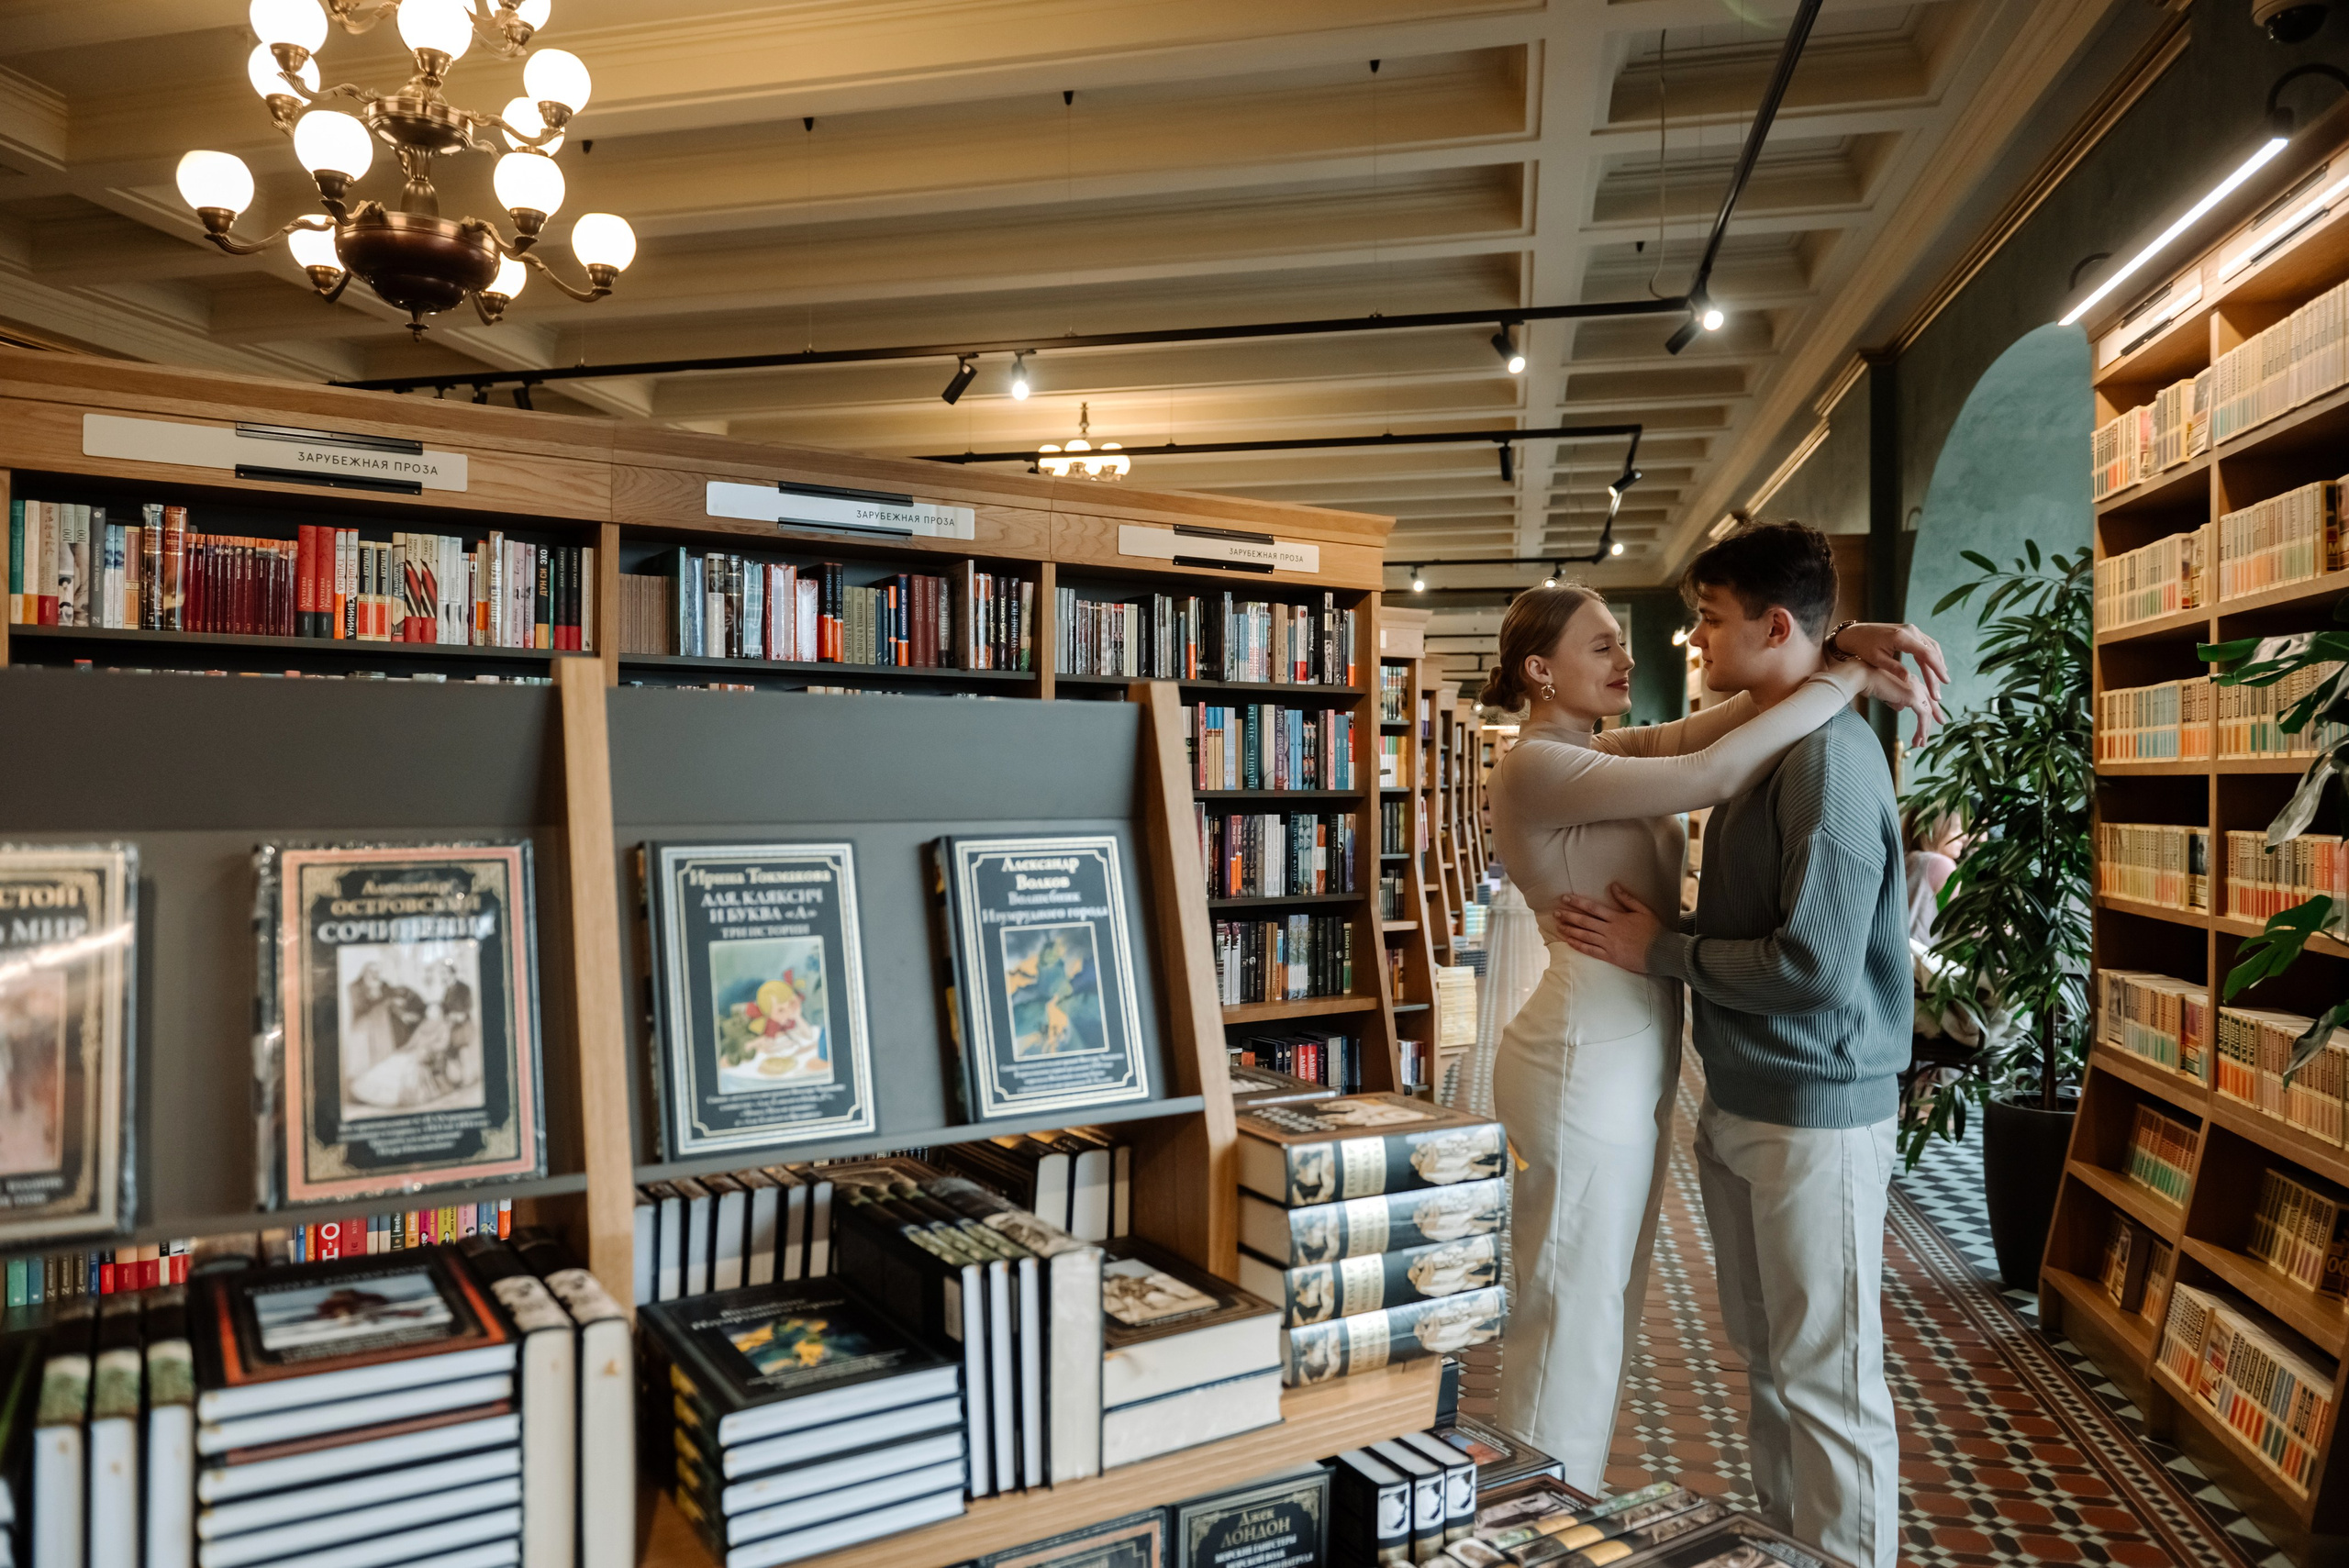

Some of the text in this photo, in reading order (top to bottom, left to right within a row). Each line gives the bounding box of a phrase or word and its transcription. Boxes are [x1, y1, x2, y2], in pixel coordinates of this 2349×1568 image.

[298, 451, 438, 475] ЗАРУБЕЖНАЯ ПРОЗА
[857, 510, 954, 526] ЗАРУБЕЖНАЯ ПРОЗА
[62, 529, 72, 541] 100
[1230, 548, 1303, 562] ЗАРУБЕЖНАЯ ПРОЗА
[540, 568, 547, 578] СИ
[540, 581, 548, 596] ДУН
[1001, 857, 1080, 874] Александр
[689, 867, 832, 890] Ирина Токмакова
[1015, 873, 1071, 890] Волков
[709, 908, 725, 923] И
[726, 906, 783, 923] БУКВА
[1239, 1507, 1275, 1527] Джек
[1220, 1517, 1291, 1548] ЛОНДОН
